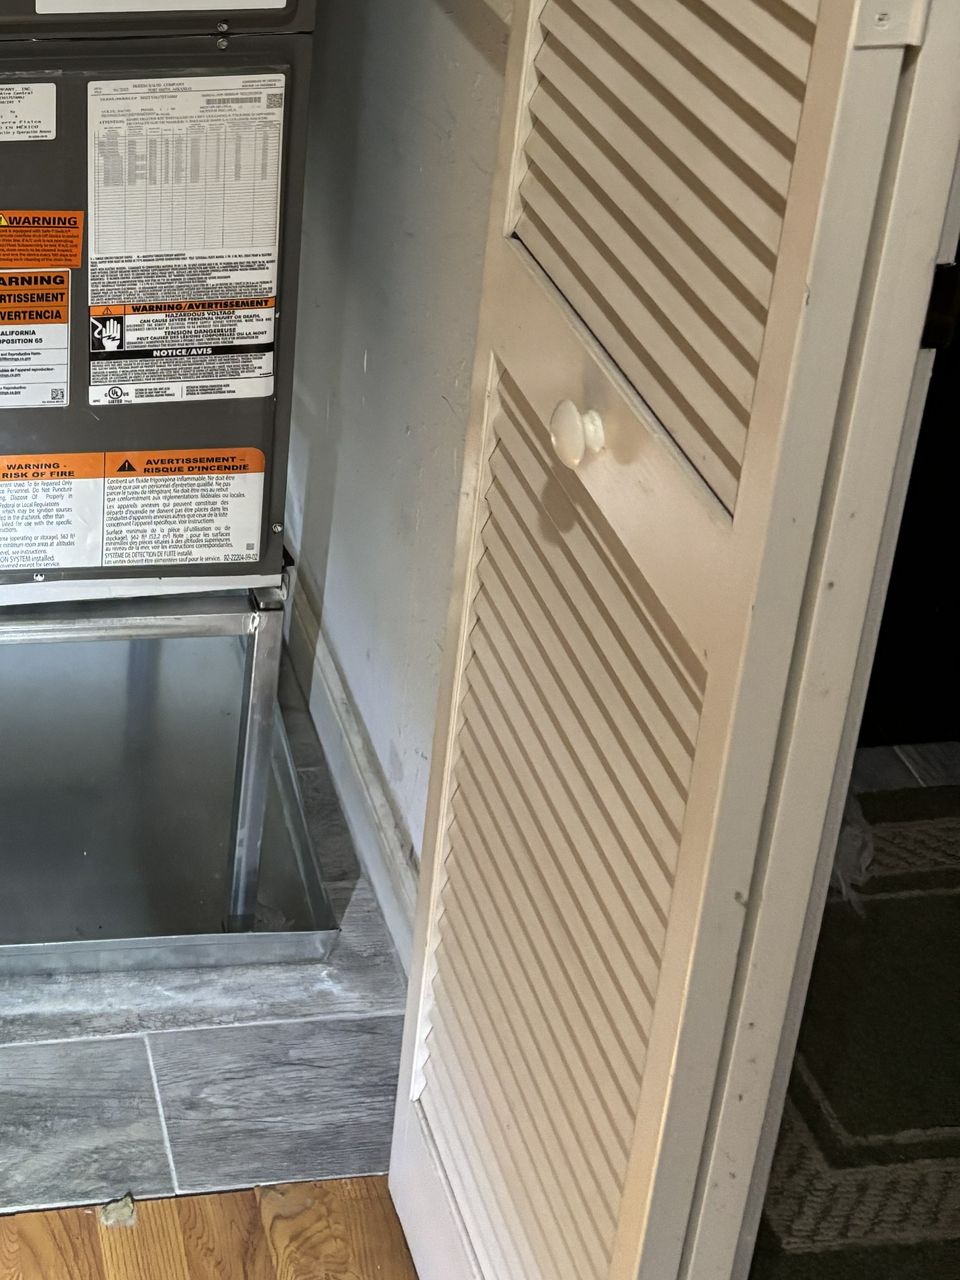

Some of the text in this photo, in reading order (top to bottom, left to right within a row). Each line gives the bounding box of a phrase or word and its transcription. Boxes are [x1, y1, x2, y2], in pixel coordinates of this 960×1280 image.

[9, 217, 77, 225] WARNING
[132, 300, 269, 312] WARNING/AVERTISSEMENT
[152, 348, 213, 357] NOTICE/AVIS
[146, 456, 236, 465] AVERTISSEMENT
[7, 462, 60, 470] WARNING
[188, 464, 249, 472] D'INCENDIE
